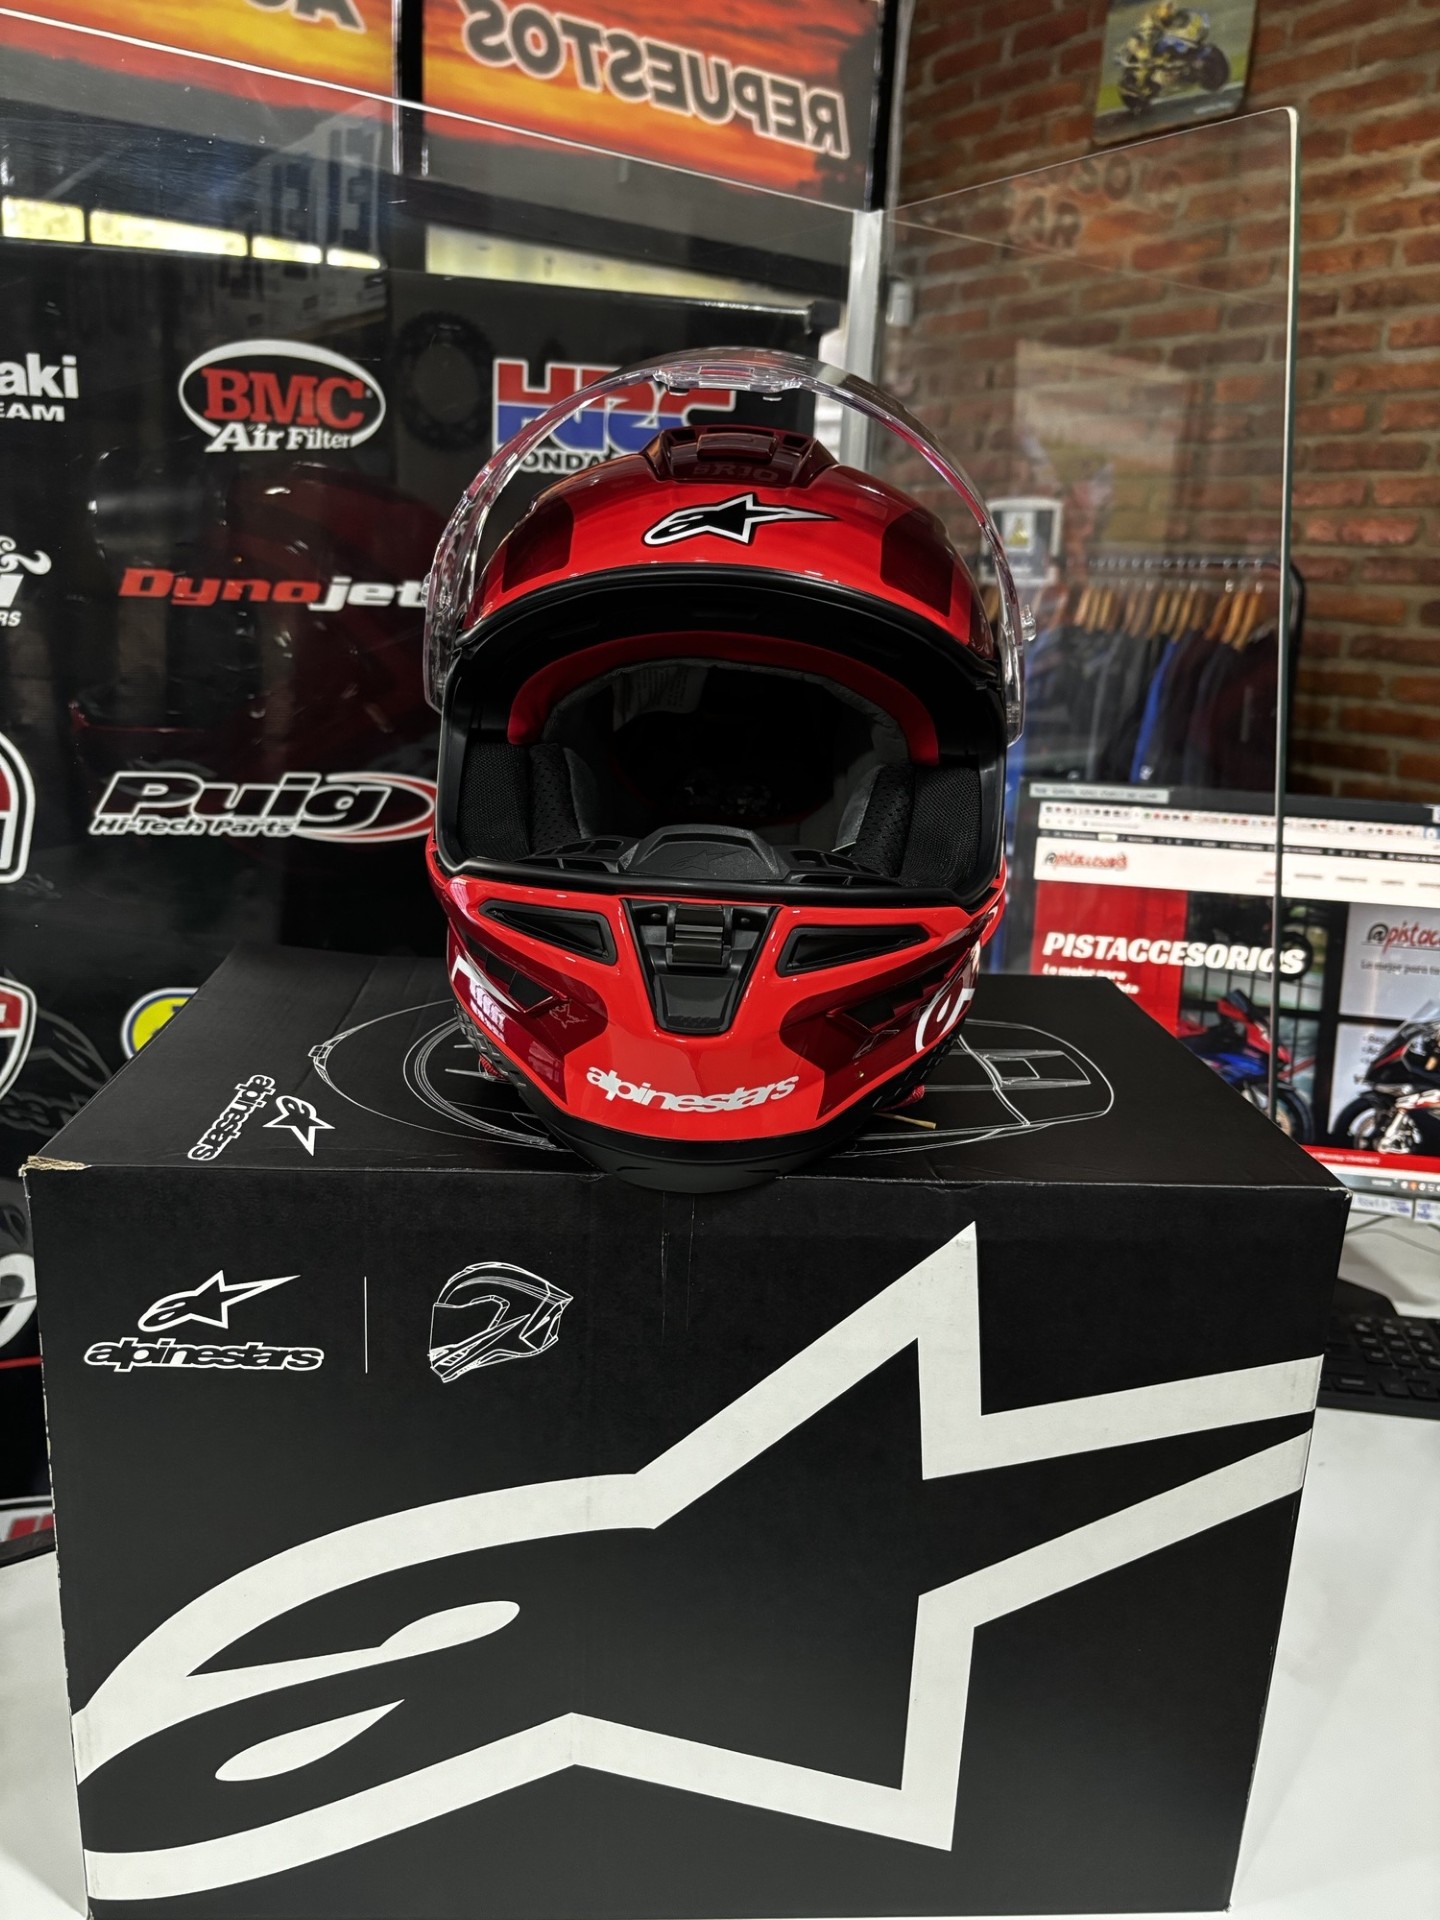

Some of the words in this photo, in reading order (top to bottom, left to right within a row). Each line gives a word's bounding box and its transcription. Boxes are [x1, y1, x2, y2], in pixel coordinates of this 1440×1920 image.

[0, 401, 66, 422] AM
[201, 367, 366, 430] BMC
[204, 421, 285, 453] Air
[285, 426, 352, 451] Filter
[118, 567, 428, 612] Dynojet
[96, 771, 393, 833] Puig
[89, 814, 204, 835] Hi-Tech
[208, 817, 300, 837] Parts
[1042, 931, 1306, 974] PISTACCESORIOS
[586, 1066, 800, 1113] alpinestars
[187, 1074, 276, 1161] alpinestars
[84, 1337, 325, 1373] alpinestars
